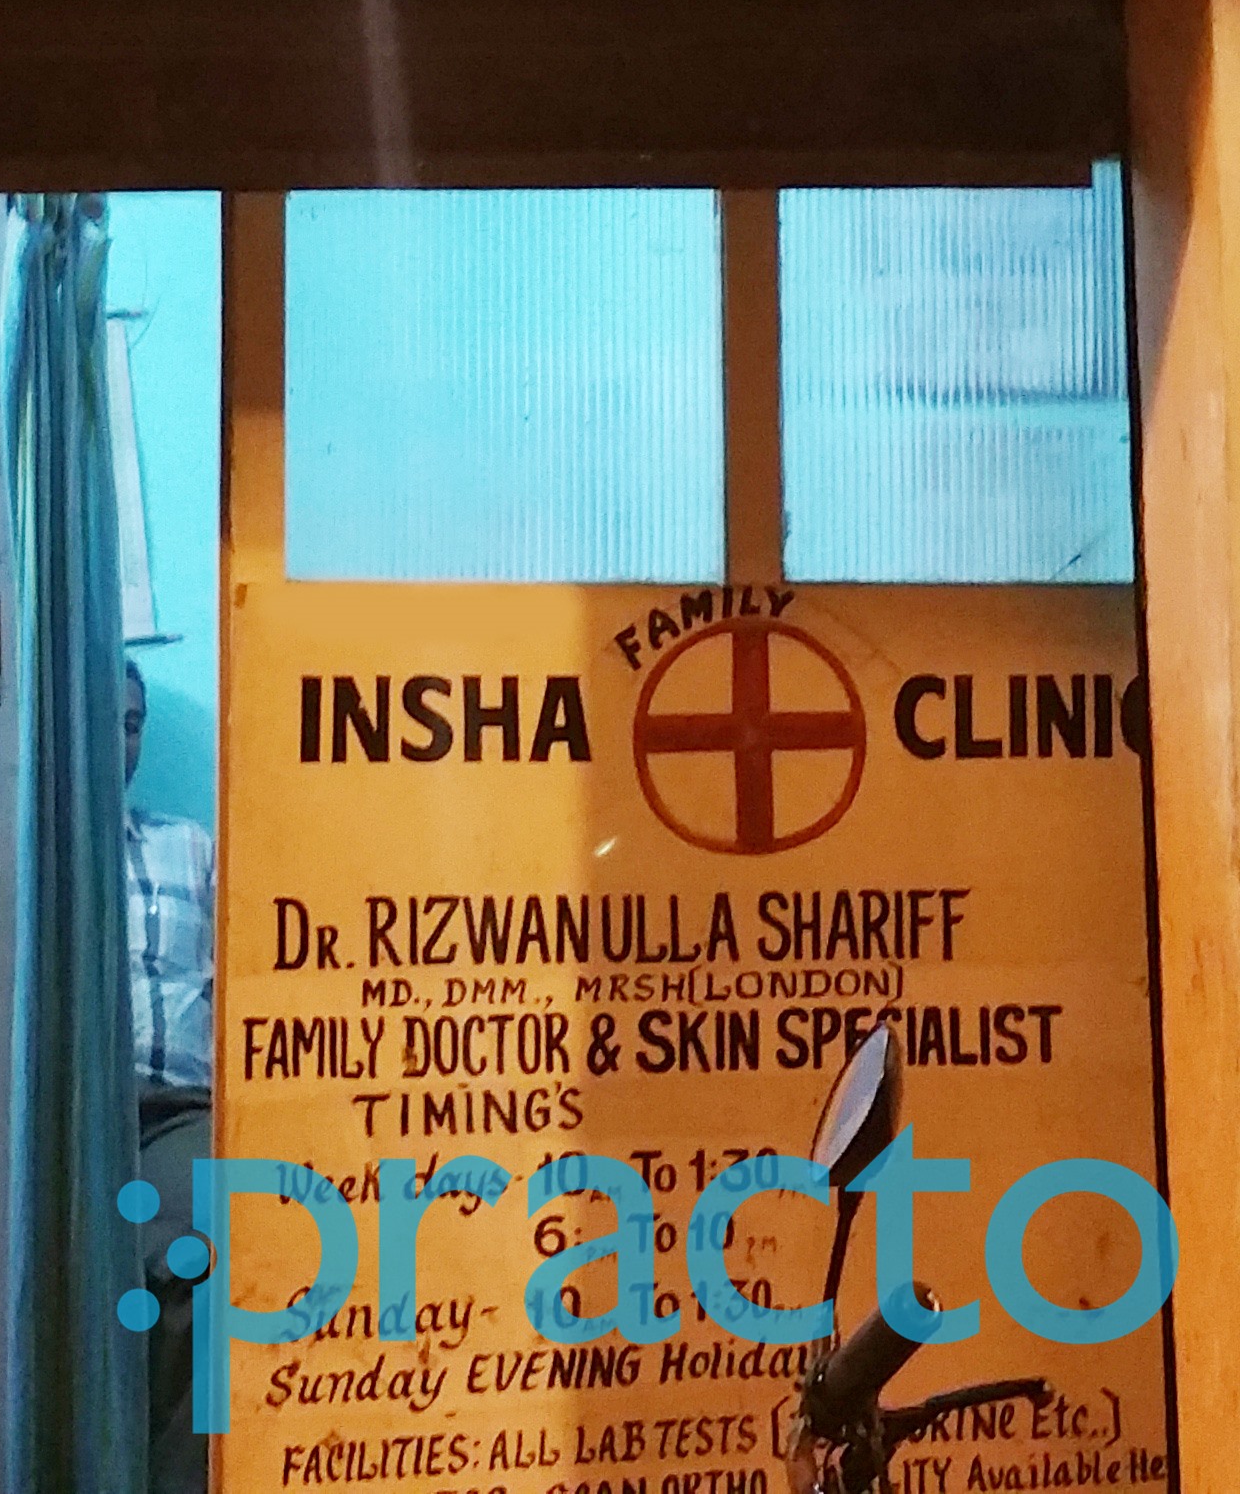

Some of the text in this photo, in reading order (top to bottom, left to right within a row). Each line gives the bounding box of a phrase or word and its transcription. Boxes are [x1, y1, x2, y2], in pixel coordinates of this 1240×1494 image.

[614, 584, 795, 672] FAMILY
[298, 673, 593, 764] INSHA
[364, 892, 739, 967] RIZWANULLA
[756, 888, 972, 963] SHARIFF
[242, 1015, 386, 1081] FAMILY
[402, 1013, 571, 1079] DOCTOR
[586, 1012, 622, 1077] &
[635, 1009, 760, 1074] SKIN
[630, 1150, 678, 1193] To
[626, 1211, 678, 1254] To
[688, 1209, 736, 1252] 10
[527, 1284, 582, 1330] 10
[627, 1281, 680, 1326] To
[265, 1353, 449, 1413] Sunday
[466, 1343, 643, 1395] EVENING
[488, 1427, 561, 1472] ALL
[574, 1419, 647, 1465] LAB
[654, 1413, 759, 1460] TESTS
[966, 1451, 1122, 1493] Available
